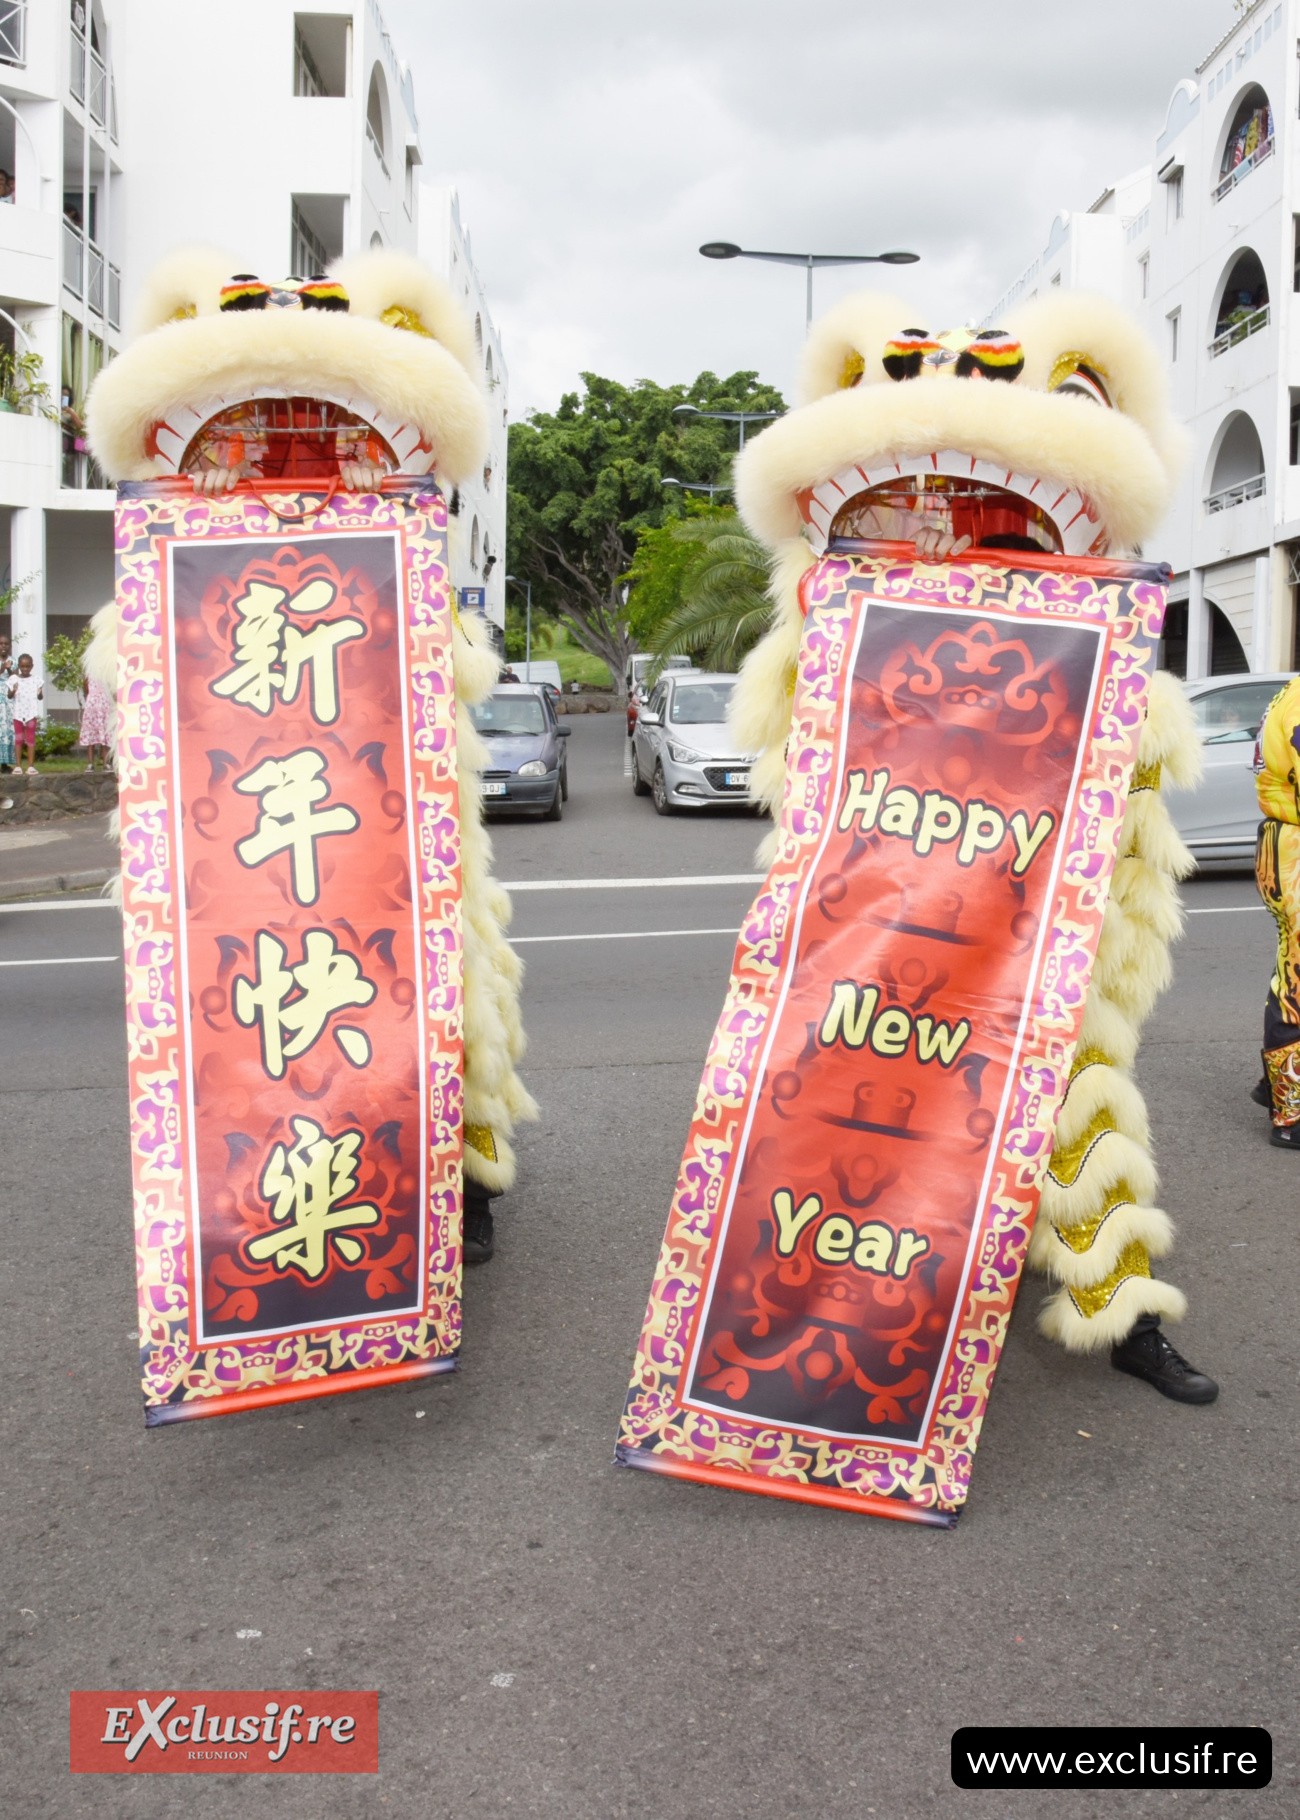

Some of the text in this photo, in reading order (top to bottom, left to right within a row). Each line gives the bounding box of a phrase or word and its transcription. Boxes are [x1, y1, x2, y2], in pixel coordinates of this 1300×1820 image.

[839, 769, 1053, 876] Happy
[210, 580, 380, 1279] 新年快樂
[820, 980, 969, 1067] New
[772, 1187, 928, 1279] Year
